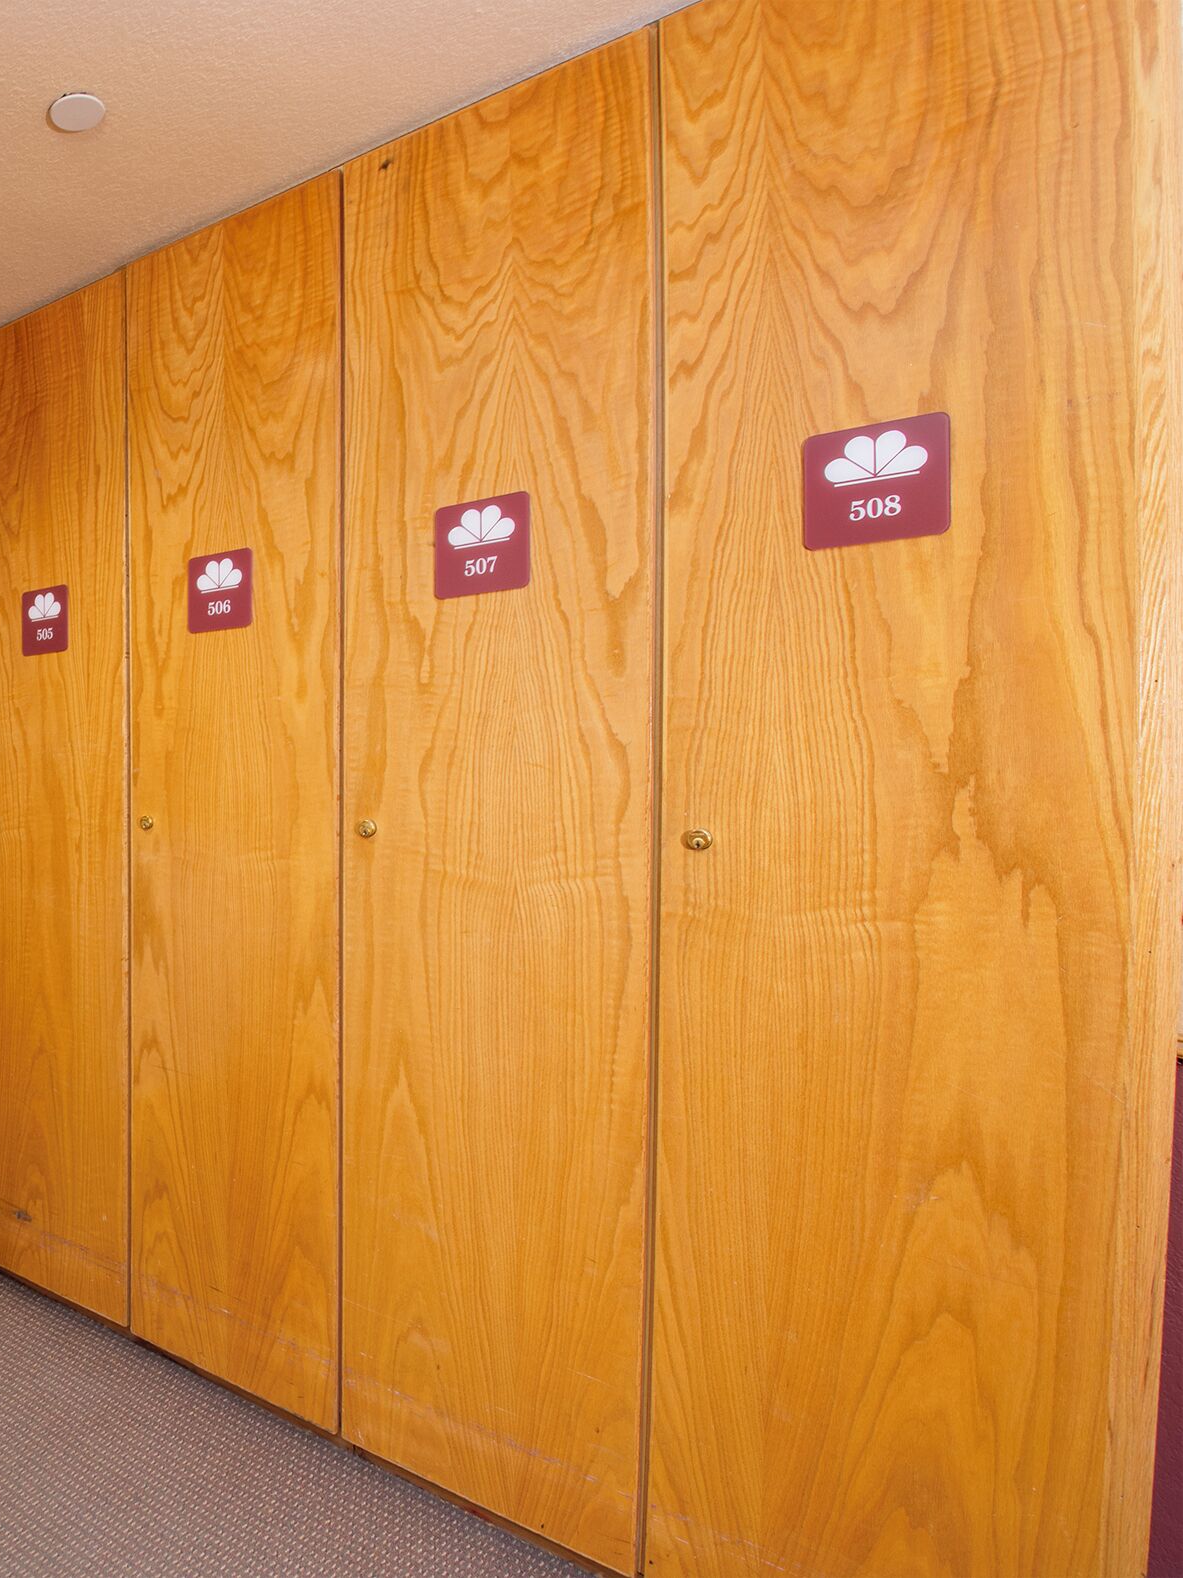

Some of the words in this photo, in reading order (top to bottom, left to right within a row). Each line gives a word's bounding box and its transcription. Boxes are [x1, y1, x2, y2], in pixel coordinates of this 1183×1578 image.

[849, 494, 902, 521] 508
[464, 555, 498, 577] 507
[207, 599, 231, 616] 506
[36, 627, 53, 641] 505
